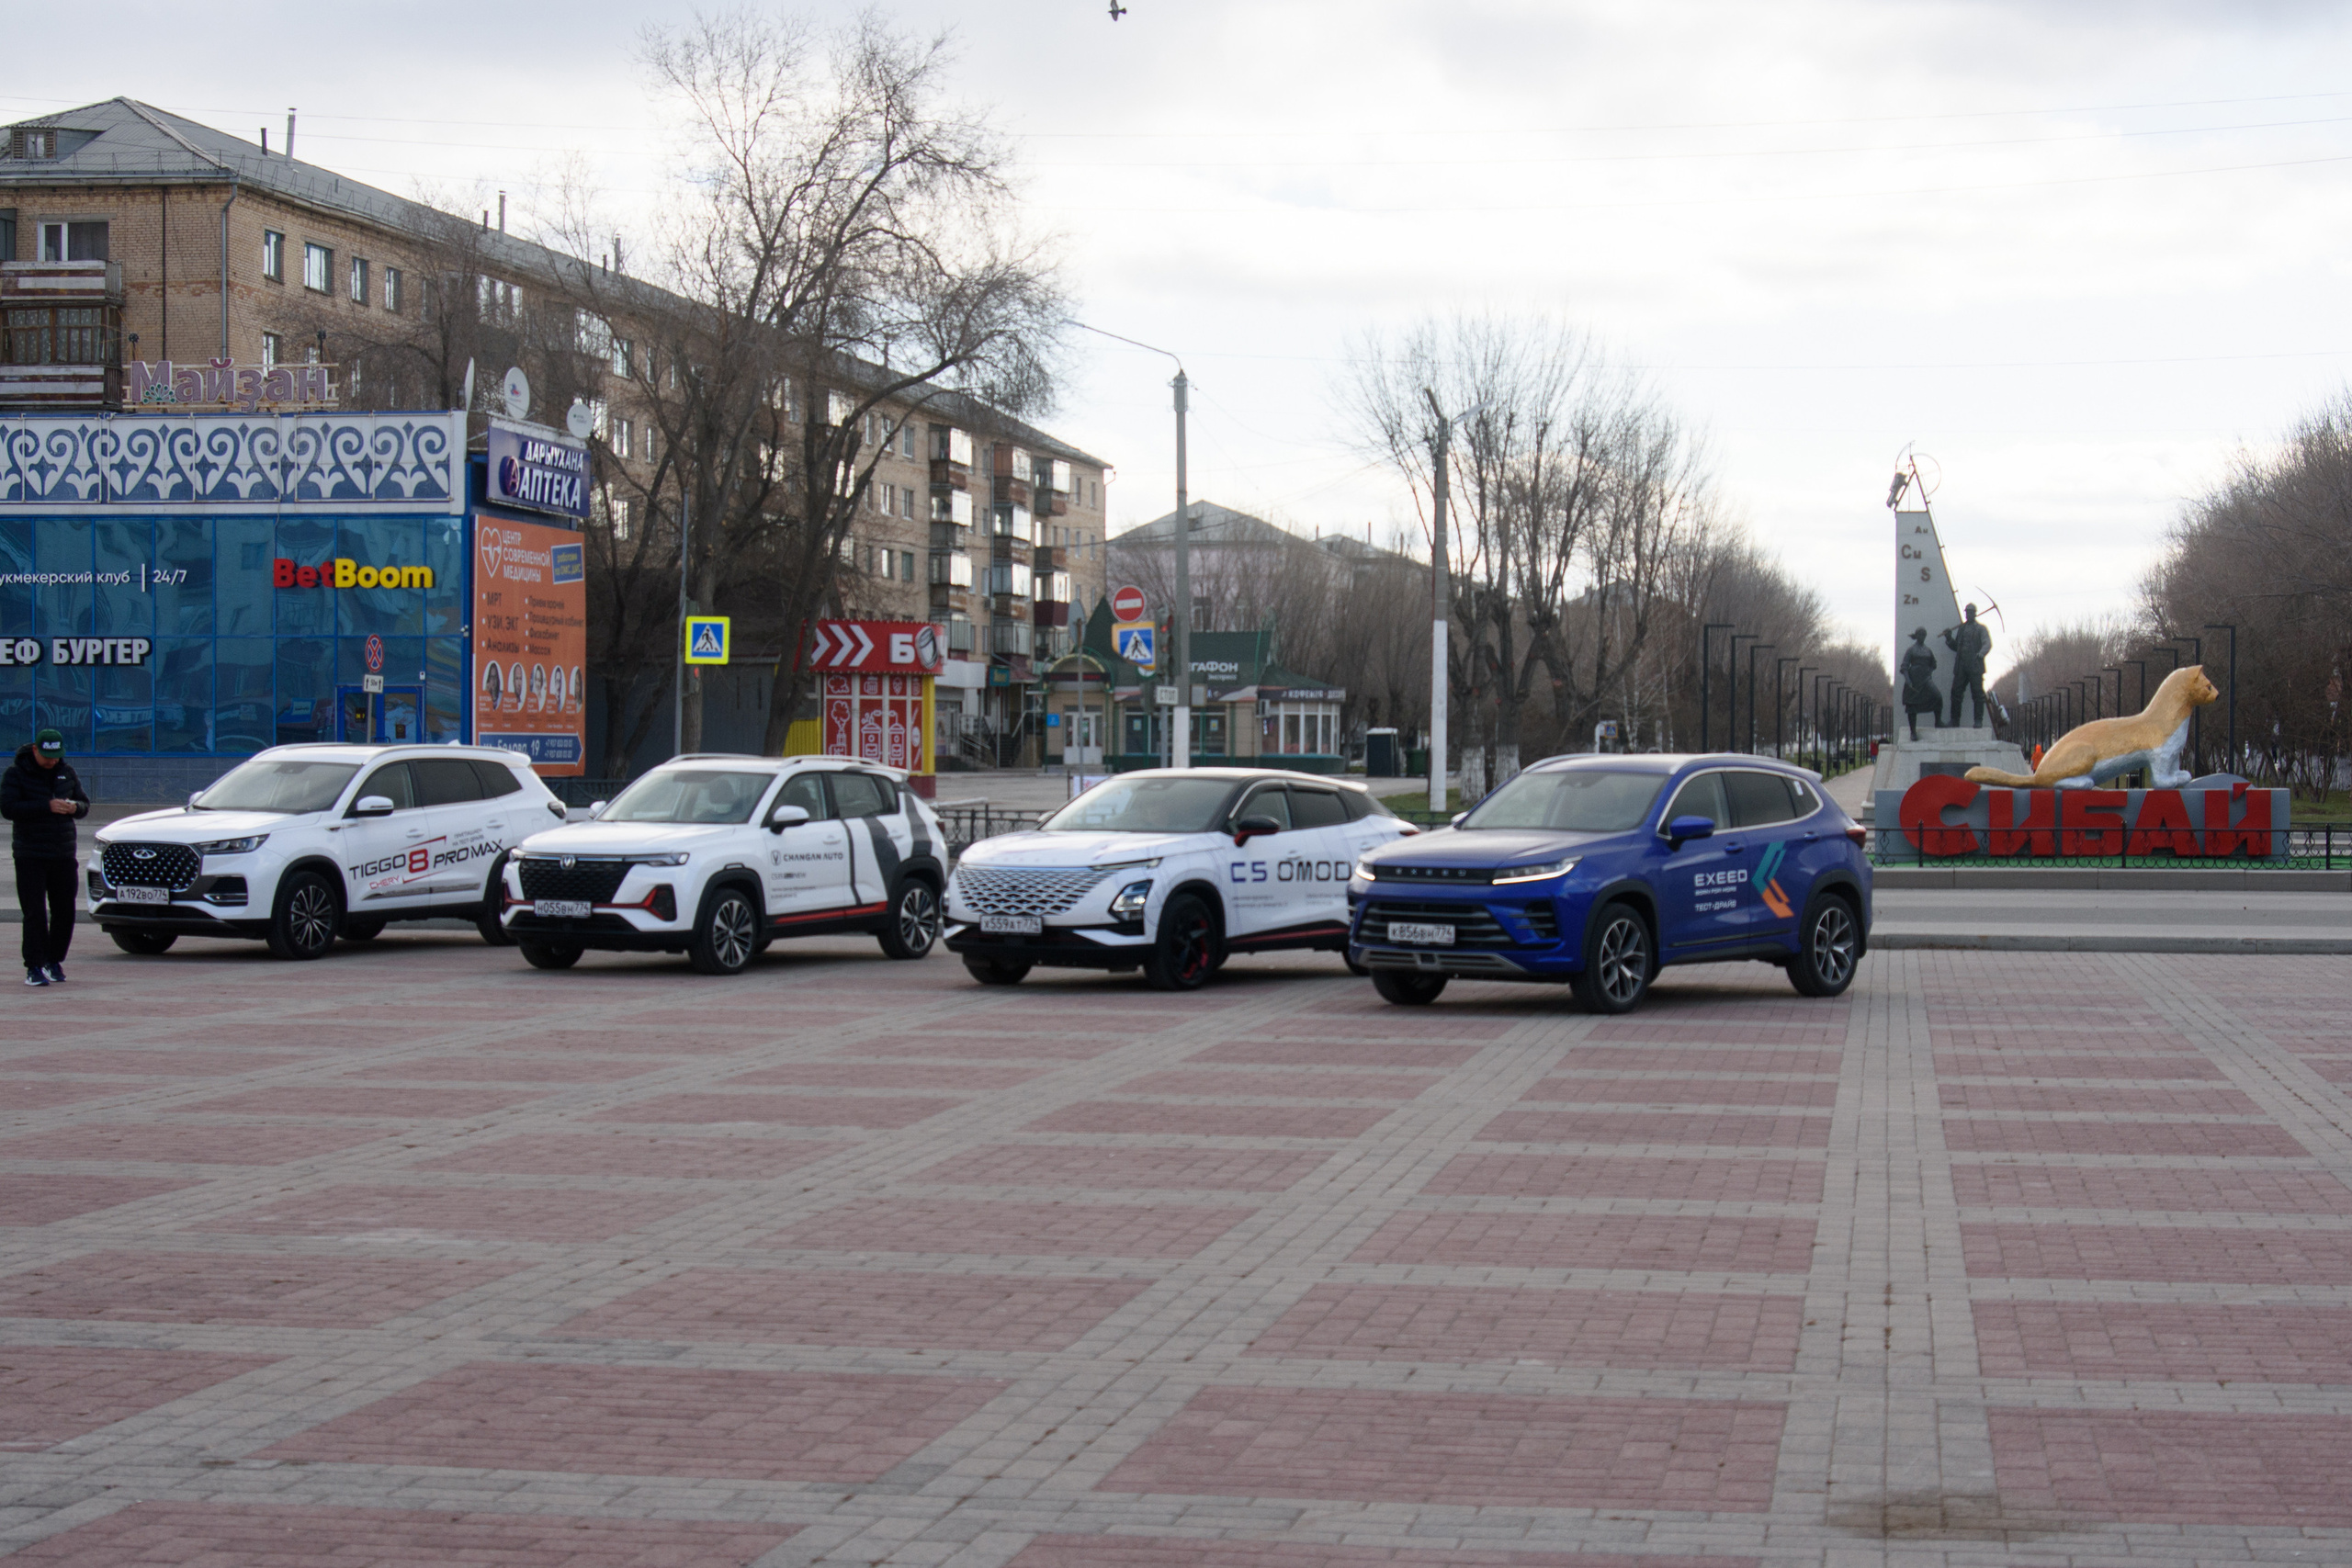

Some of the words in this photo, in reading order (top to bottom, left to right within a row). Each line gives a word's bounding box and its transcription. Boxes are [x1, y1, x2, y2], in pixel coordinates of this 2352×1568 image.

[525, 441, 583, 473] ДАРЫУХАНА
[518, 466, 581, 510] АПТЕКА
[502, 530, 522, 546] ЦЕНТР
[1915, 525, 1928, 534] Au
[503, 547, 551, 567] СОВРЕМЕННОЙ
[1901, 544, 1921, 559] Cu
[96, 570, 130, 586] клуб
[153, 570, 187, 586] 24/7
[273, 558, 434, 589] BetBoom
[503, 564, 541, 583] МЕДИЦИНЫ
[1920, 566, 1931, 581] S
[487, 592, 502, 606] МРТ
[1904, 593, 1919, 605] Zn
[505, 615, 519, 632] ЭКГ
[52, 638, 151, 665] БУРГЕР
[487, 637, 520, 654] Анализы
[531, 739, 540, 757] 19
[1899, 774, 2272, 858] СИБАЙ
[349, 853, 407, 880] TIGGO
[408, 848, 429, 874] 8
[433, 847, 469, 869] PRO
[470, 838, 504, 860] MAX
[783, 852, 822, 862] CHANGAN
[823, 851, 843, 861] AUTO
[1231, 862, 1267, 882] C5
[1694, 869, 1748, 887] EXEED
[369, 875, 401, 890] CHERY
